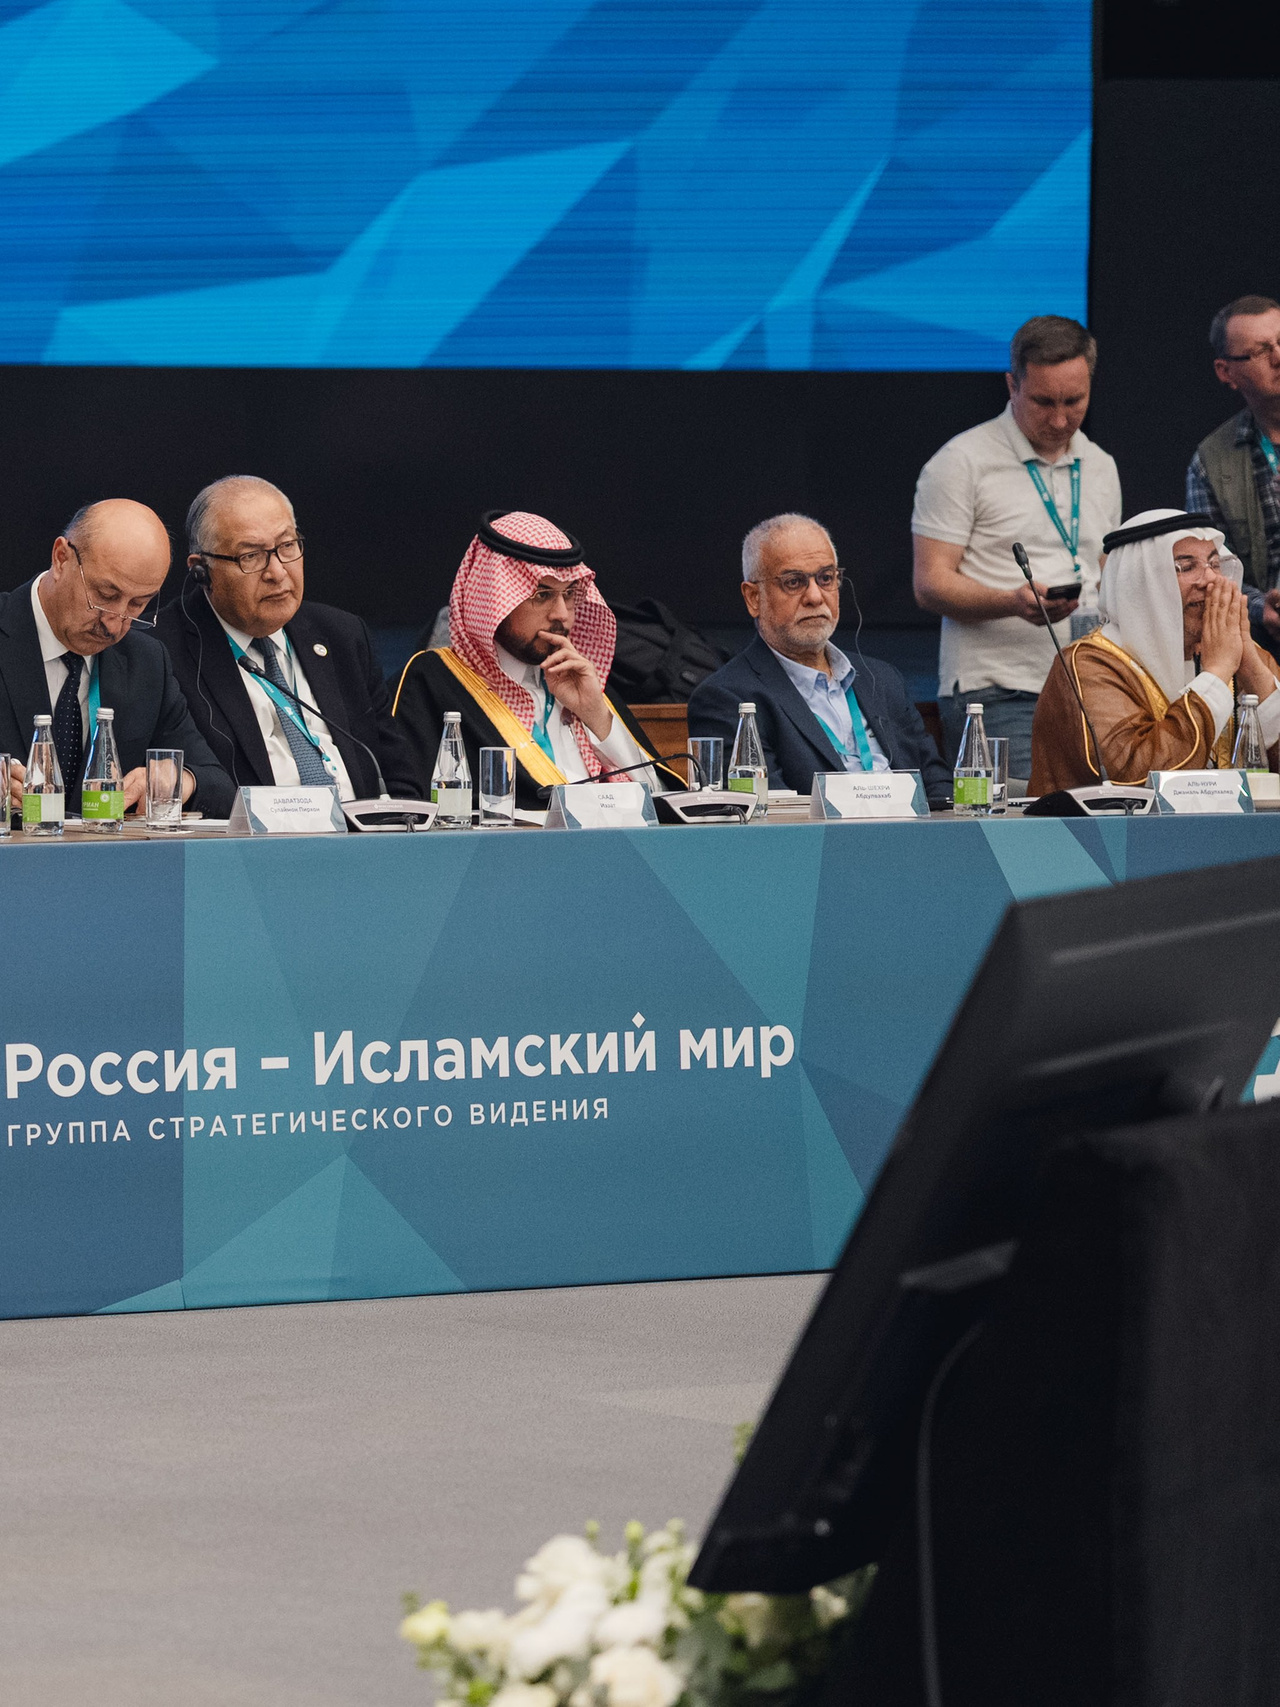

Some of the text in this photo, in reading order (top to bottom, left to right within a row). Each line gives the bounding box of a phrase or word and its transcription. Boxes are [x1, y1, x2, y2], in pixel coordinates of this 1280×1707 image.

[6, 1044, 238, 1100] Россия
[315, 1012, 657, 1087] Исламский
[680, 1026, 797, 1080] мир
[7, 1097, 610, 1149] ГРУППА СТРАТЕГИЧЕСКОГО ВИДЕНИЯ
